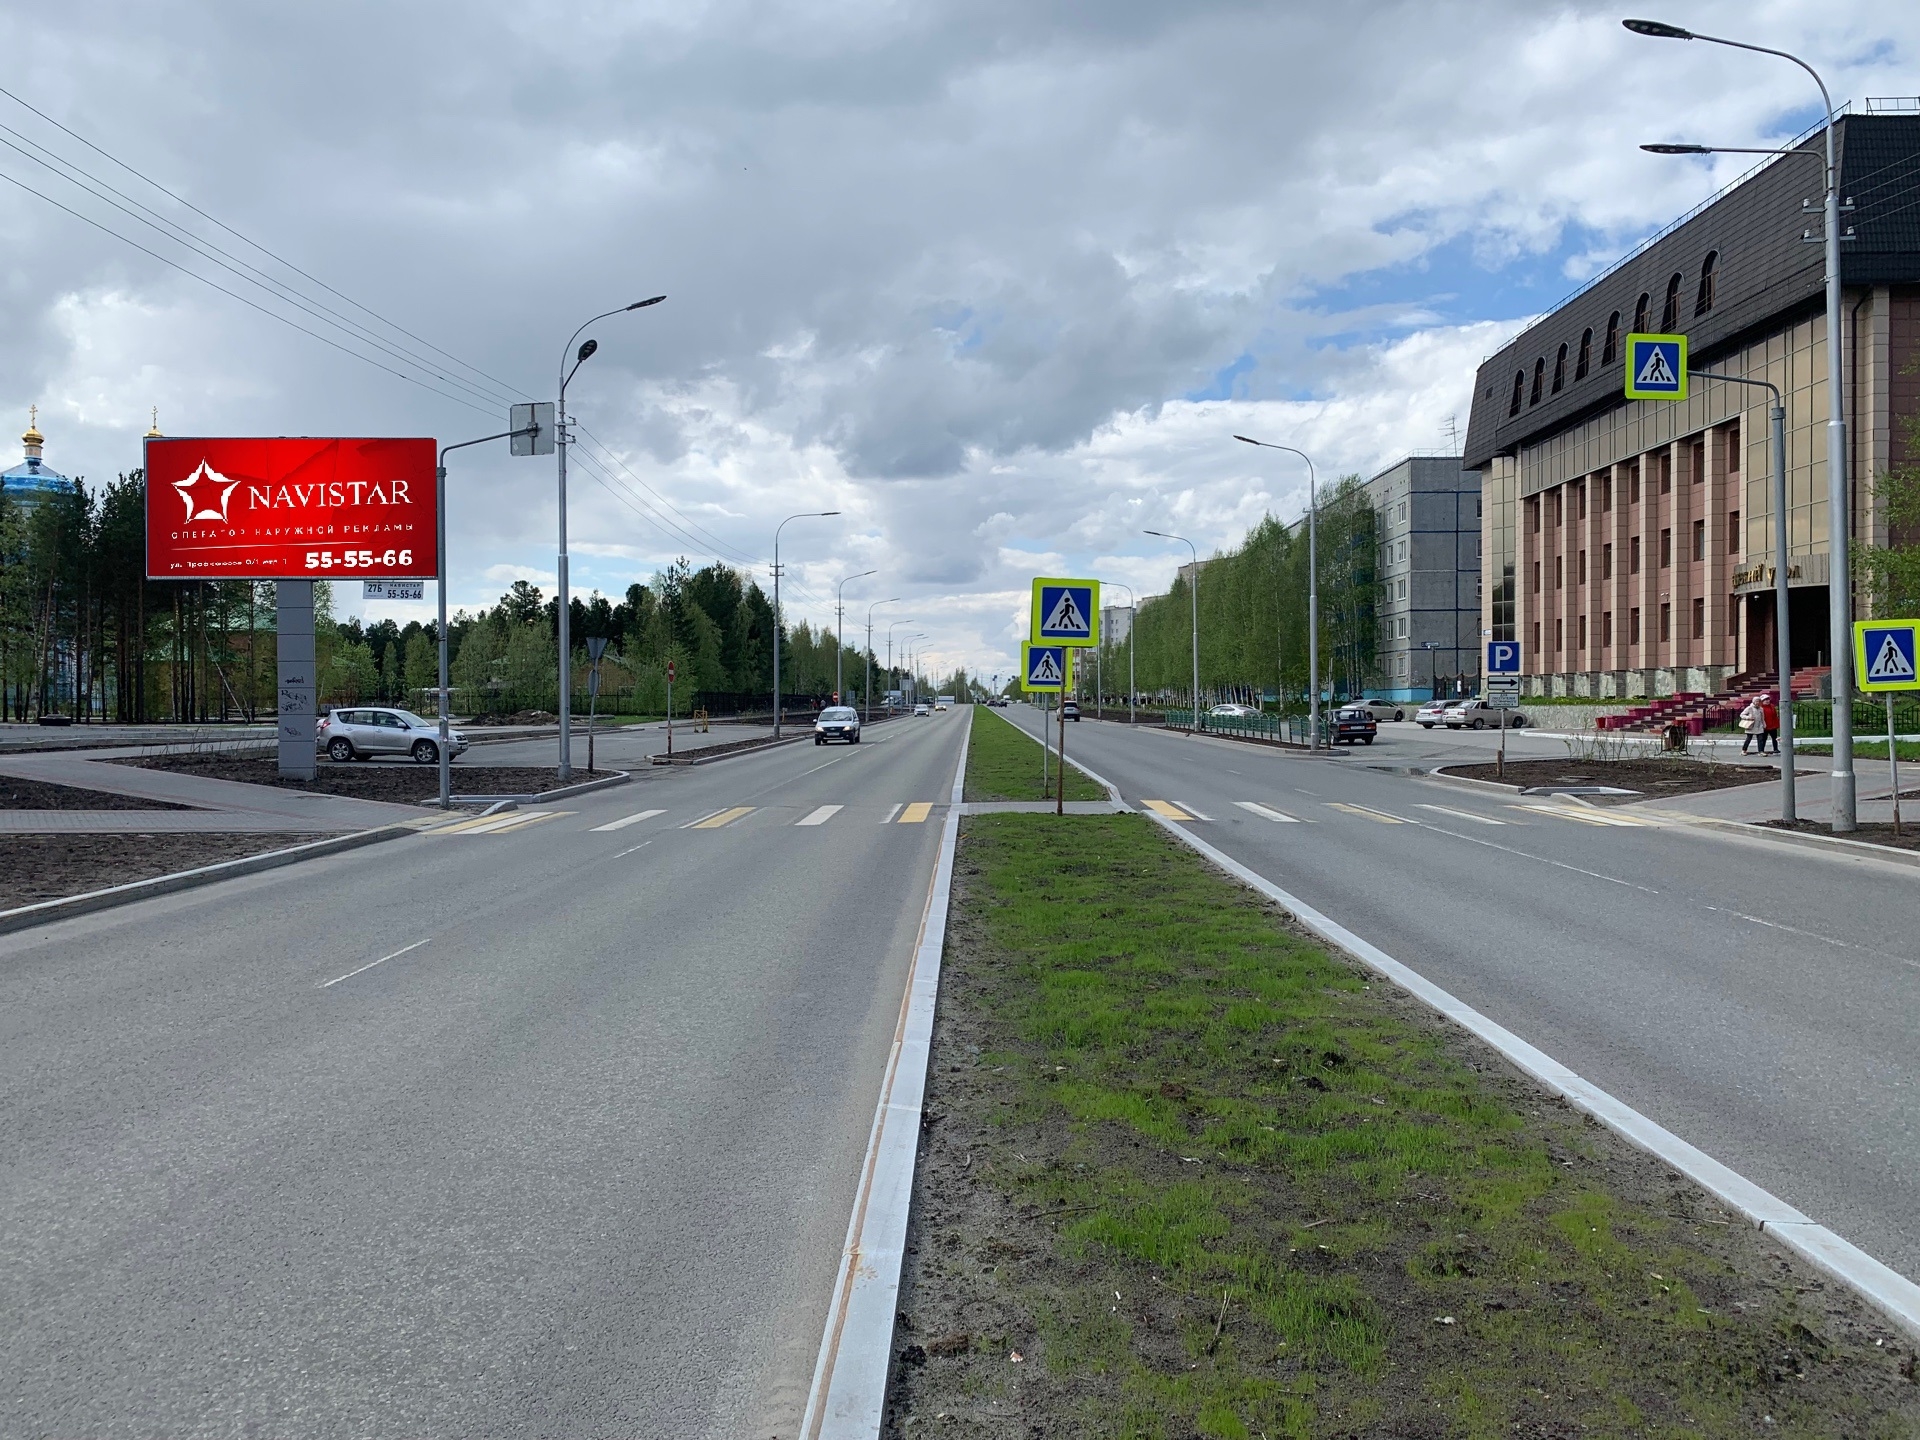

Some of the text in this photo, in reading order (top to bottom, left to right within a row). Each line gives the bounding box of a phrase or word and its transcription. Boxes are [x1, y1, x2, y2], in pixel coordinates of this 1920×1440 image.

[247, 480, 413, 510] NAVISTAR
[255, 525, 334, 536] НАРУЖНОЙ
[344, 523, 413, 533] РЕКЛАМЫ
[305, 550, 413, 569] 55-55-66
[387, 589, 422, 599] 55-55-66
[1495, 645, 1513, 669] P
